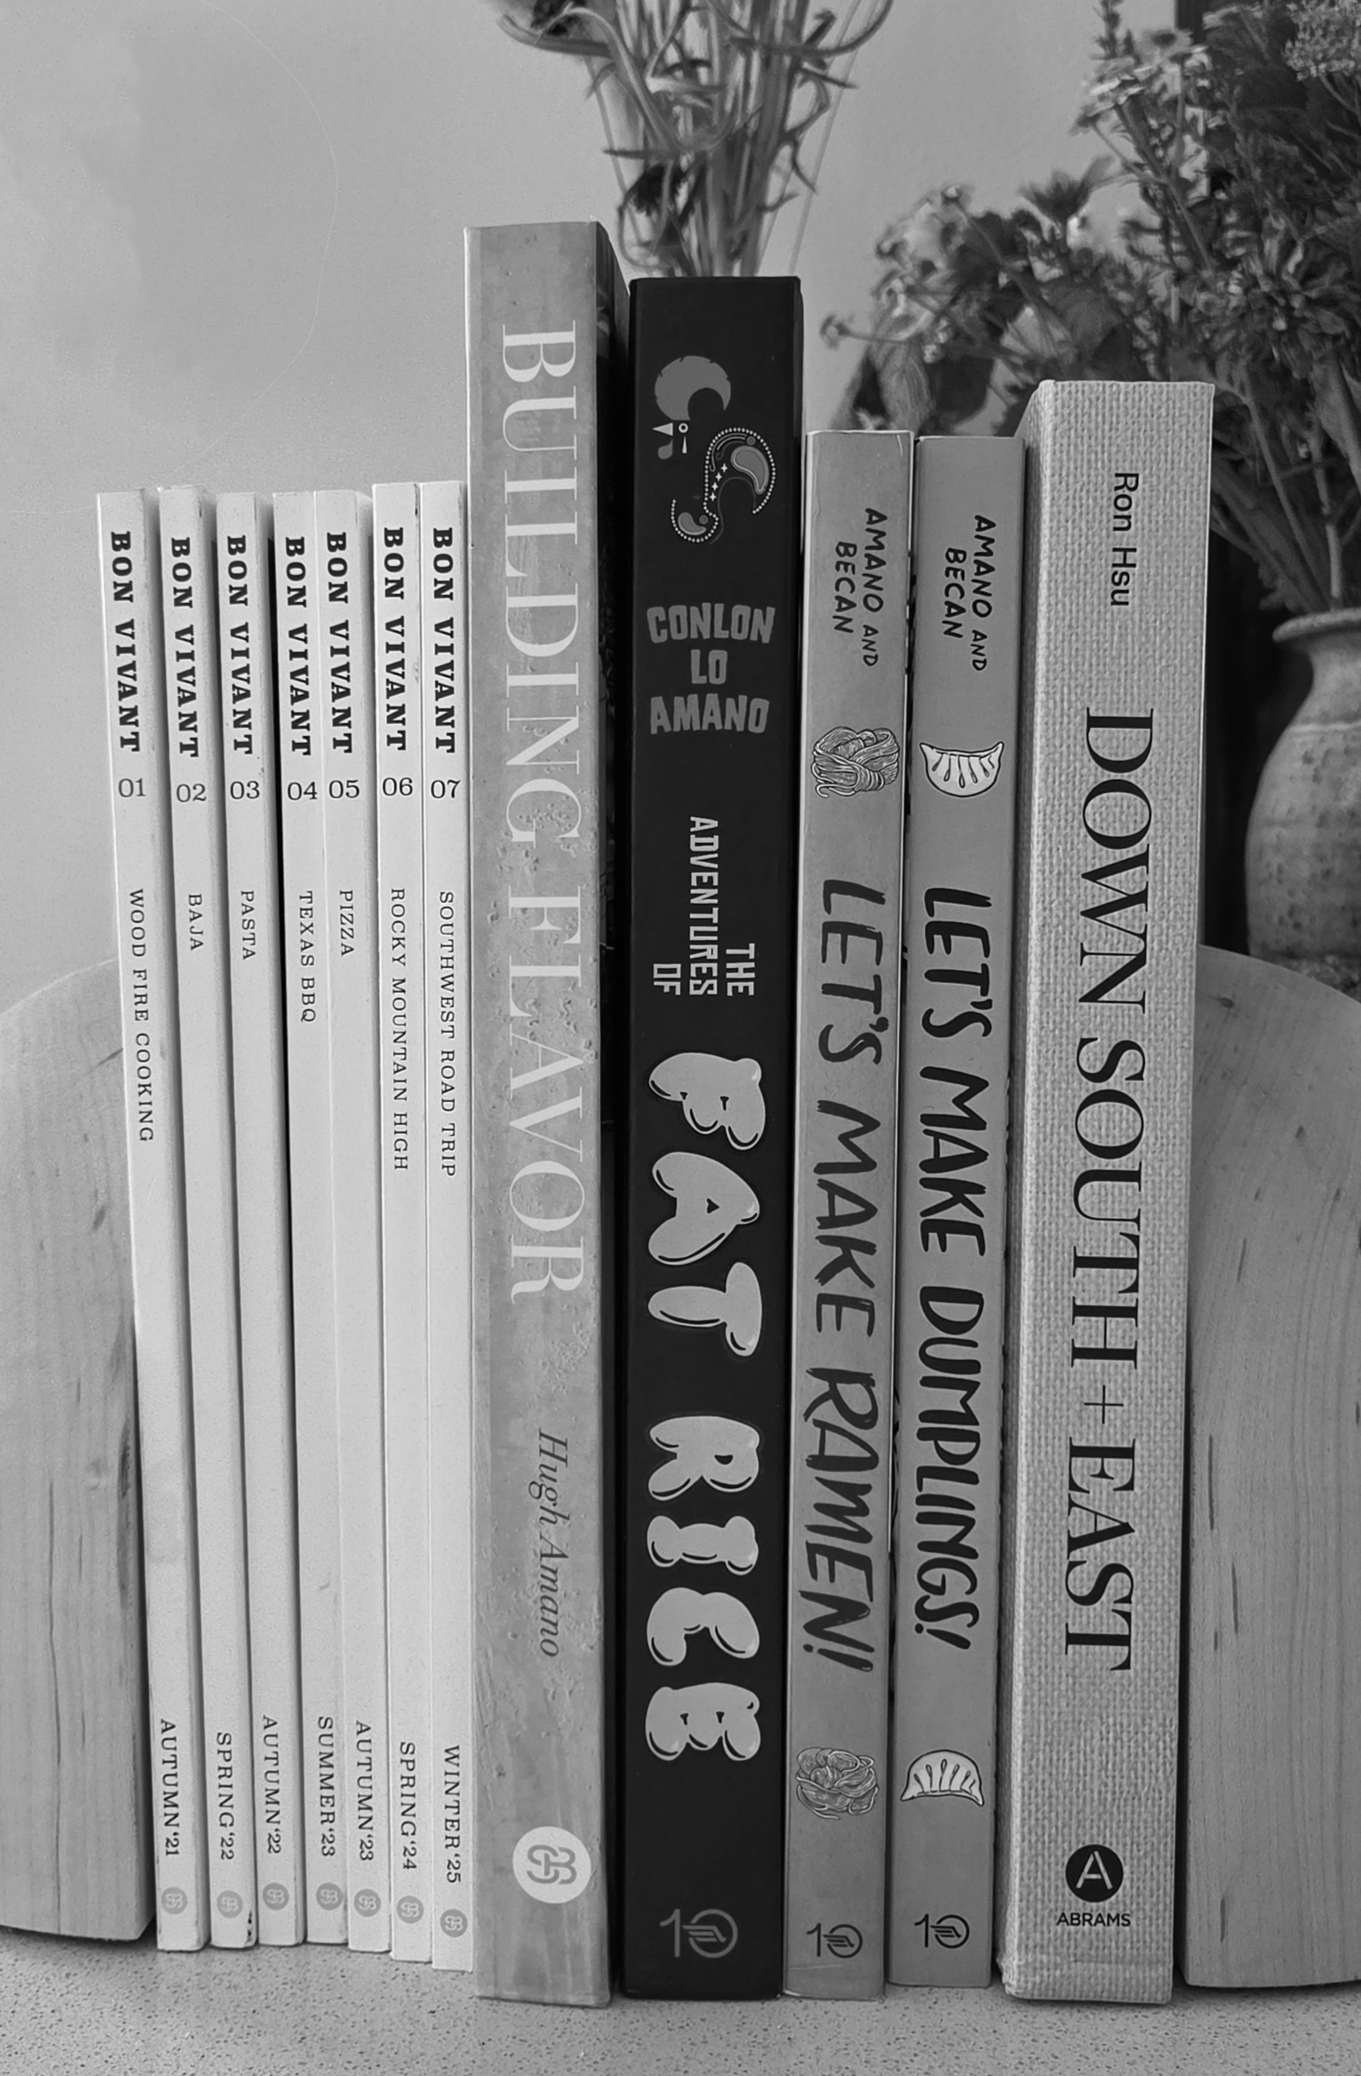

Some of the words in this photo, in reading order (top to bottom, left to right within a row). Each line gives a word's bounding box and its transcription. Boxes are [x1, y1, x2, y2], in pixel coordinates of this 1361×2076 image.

[1112, 472, 1140, 532] Ron
[110, 530, 134, 603] BON
[170, 536, 194, 609] BON
[226, 534, 249, 607] BON
[285, 536, 307, 608] BON
[326, 531, 349, 605] BON
[383, 526, 405, 600] BON
[432, 527, 454, 601] BON
[502, 320, 580, 844] BUILDING
[831, 540, 858, 634] BECAN
[861, 507, 888, 613] AMANO
[941, 547, 968, 639] BECAN
[970, 514, 997, 619] AMANO
[1110, 547, 1138, 607] Hsu
[646, 601, 776, 644] CONLON
[861, 624, 880, 667] AND
[969, 629, 988, 672] AND
[114, 618, 141, 753] VIVANT
[174, 624, 199, 758] VIVANT
[229, 621, 253, 755] VIVANT
[288, 623, 312, 756] VIVANT
[329, 619, 353, 754] VIVANT
[384, 615, 407, 751] VIVANT
[434, 616, 456, 754] VIVANT
[690, 648, 728, 686] LO
[649, 692, 770, 735] AMANO
[118, 777, 146, 798] 01
[175, 783, 207, 803] 02
[229, 780, 261, 800] 03
[287, 781, 318, 801] 04
[328, 779, 360, 799] 05
[382, 776, 414, 797] 06
[430, 779, 461, 799] 07
[1078, 706, 1154, 1015] DOWN
[129, 888, 147, 958] WOOD
[188, 893, 204, 951] BAJA
[240, 890, 257, 961] PASTA
[298, 890, 315, 967] TEXAS
[339, 889, 355, 957] PIZZA
[391, 888, 406, 967] ROCKY
[689, 816, 720, 996] ADVENTURES
[132, 968, 149, 1022] FIRE
[300, 976, 317, 1023] BBQ
[439, 891, 455, 1039] SOUTHWEST
[653, 963, 682, 996] OF
[725, 942, 756, 997] THE
[818, 879, 890, 1066] LET'S
[921, 887, 993, 1039] LET'S
[391, 977, 408, 1102] MOUNTAIN
[135, 1032, 154, 1142] COOKING
[440, 1049, 456, 1112] ROAD
[508, 886, 586, 1305] FLAVOR
[393, 1112, 409, 1170] HIGH
[441, 1122, 456, 1177] TRIP
[918, 1065, 990, 1257] MAKE
[647, 1052, 766, 1357] FAT
[813, 1099, 882, 1338] MAKE
[1070, 1036, 1146, 1370] SOUTH
[527, 1428, 570, 1526] Hugh
[914, 1285, 985, 1650] DUMPLINGS!
[798, 1367, 880, 1673] RAMEN!
[1064, 1436, 1136, 1672] EAST
[536, 1532, 570, 1657] Amano
[645, 1415, 762, 1762] RICE
[1055, 1911, 1132, 1928] ABRAMS
